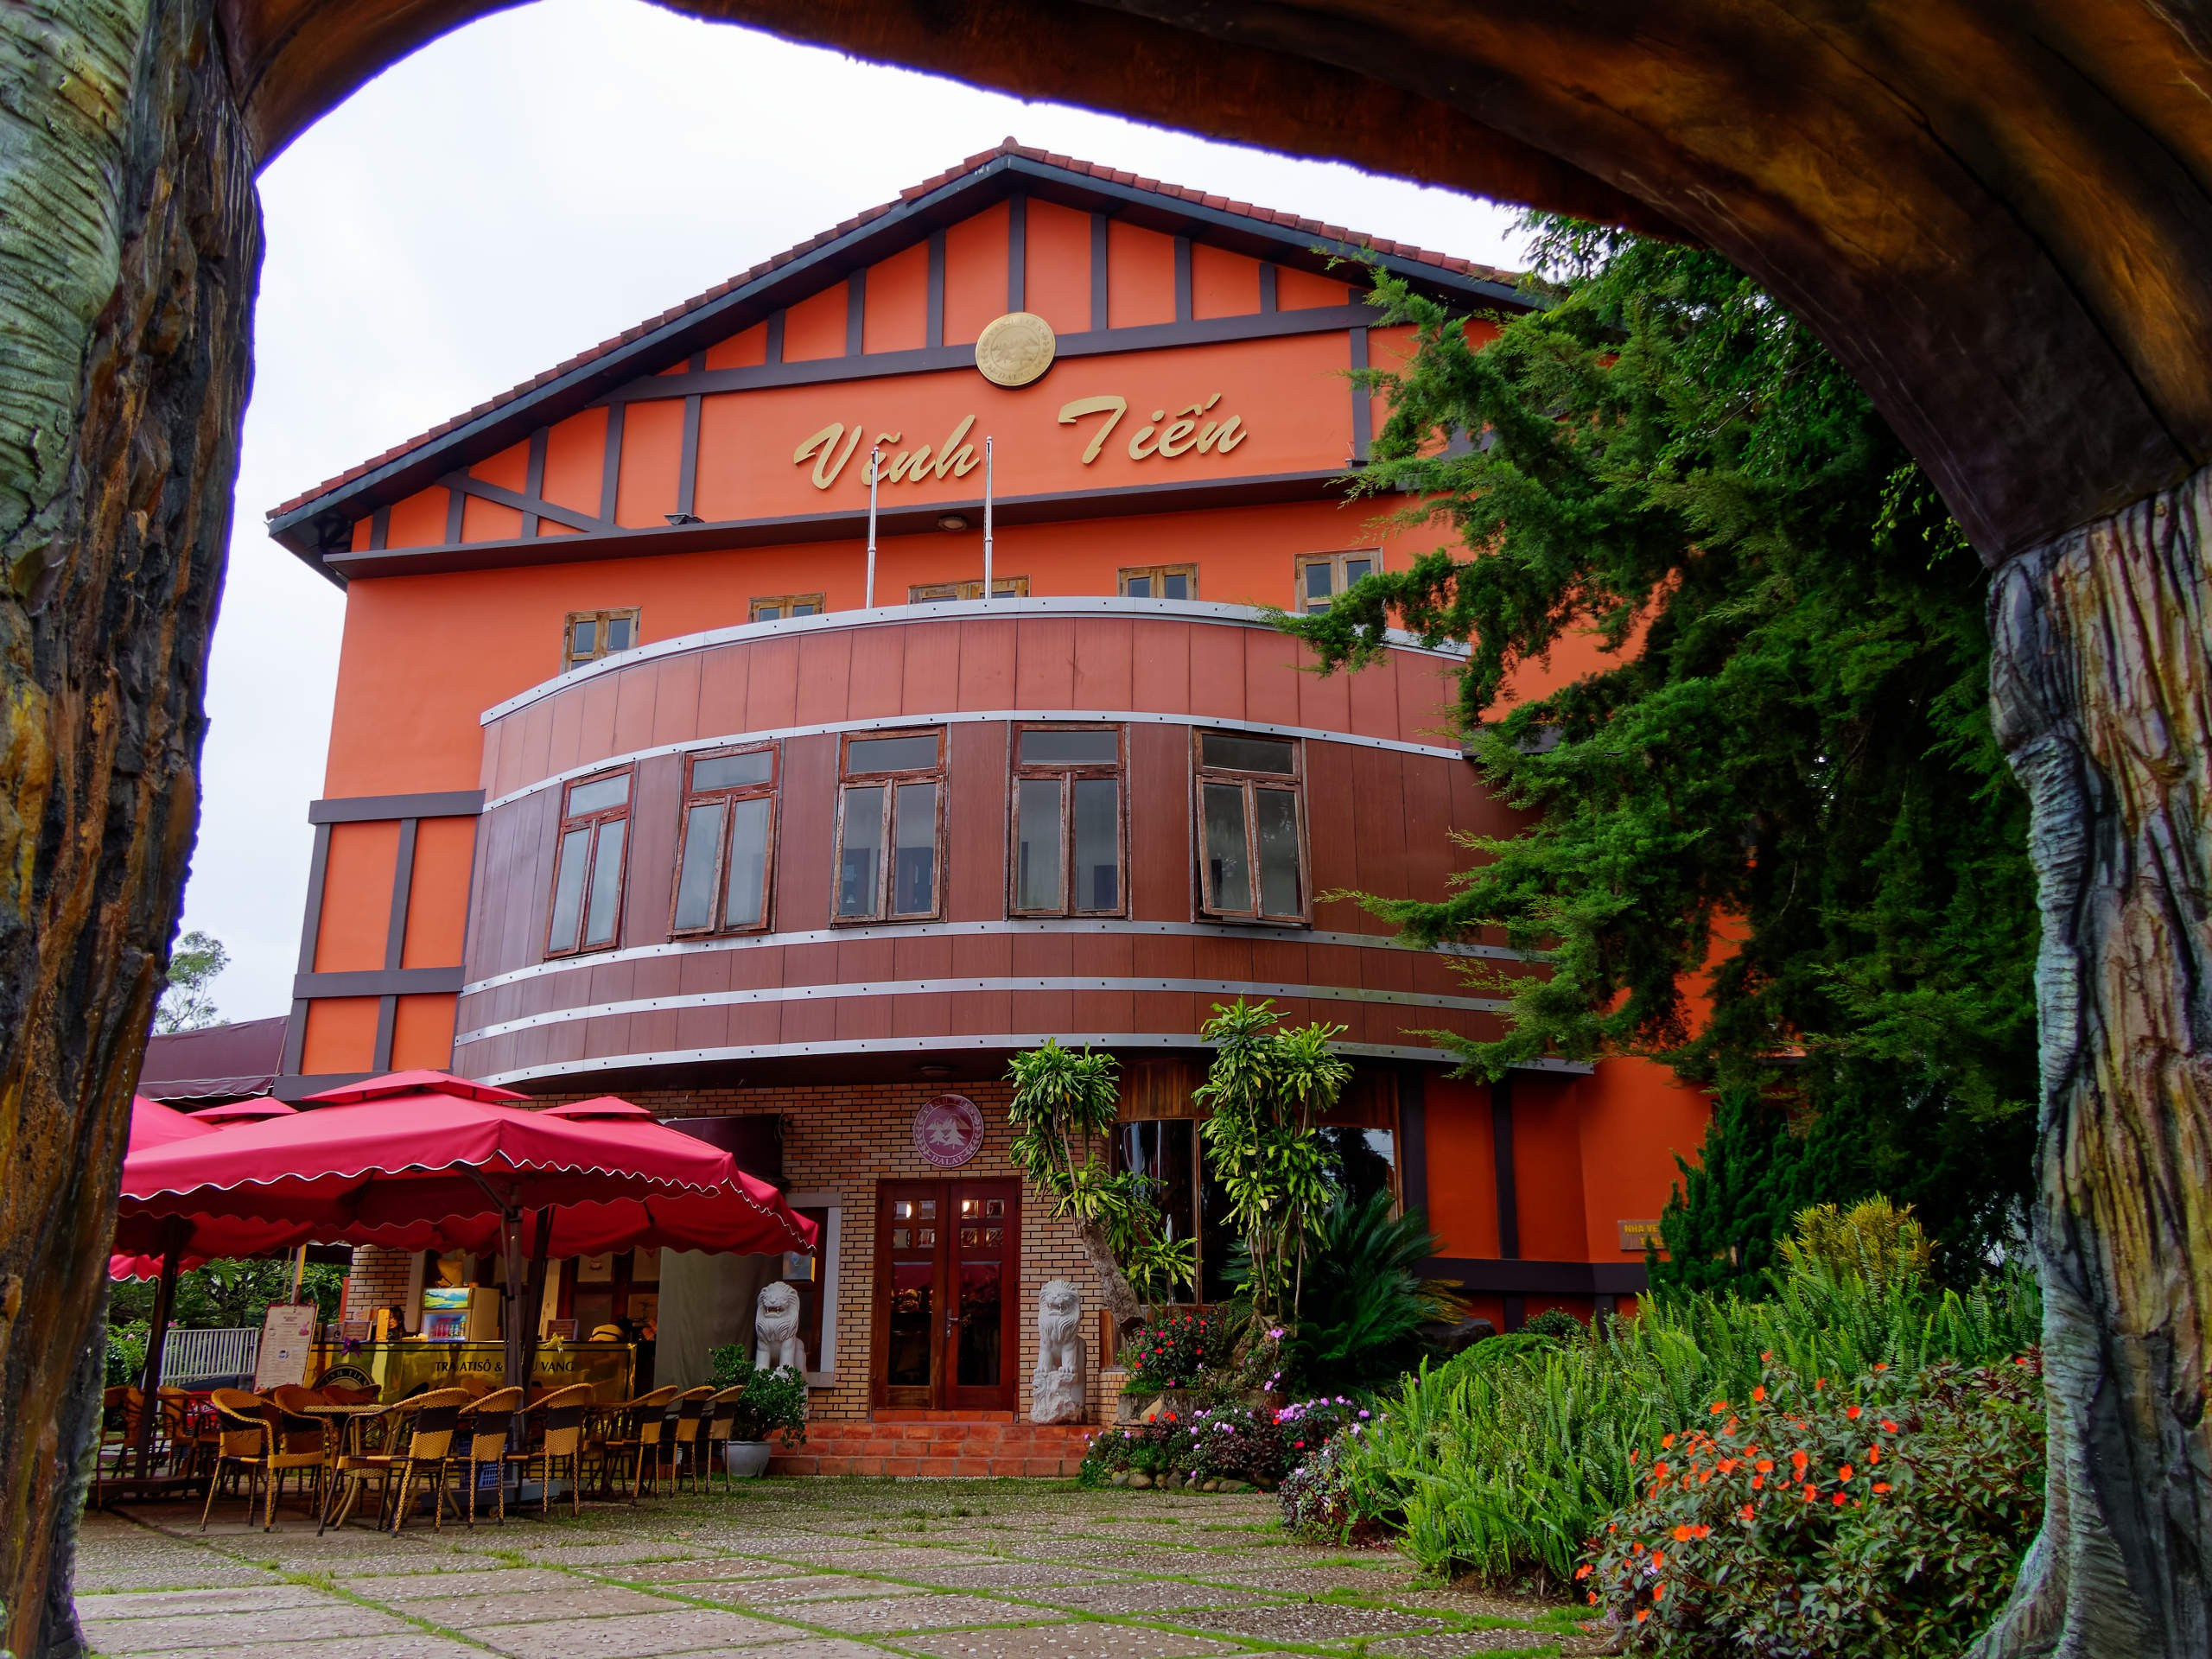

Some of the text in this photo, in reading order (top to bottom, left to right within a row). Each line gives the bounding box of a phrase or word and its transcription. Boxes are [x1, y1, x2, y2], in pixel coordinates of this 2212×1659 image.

[793, 392, 1247, 490] Vĩnh Tiến
[931, 1154, 963, 1166] DALAT
[494, 1362, 503, 1372] &
[541, 1361, 575, 1372] VANG
